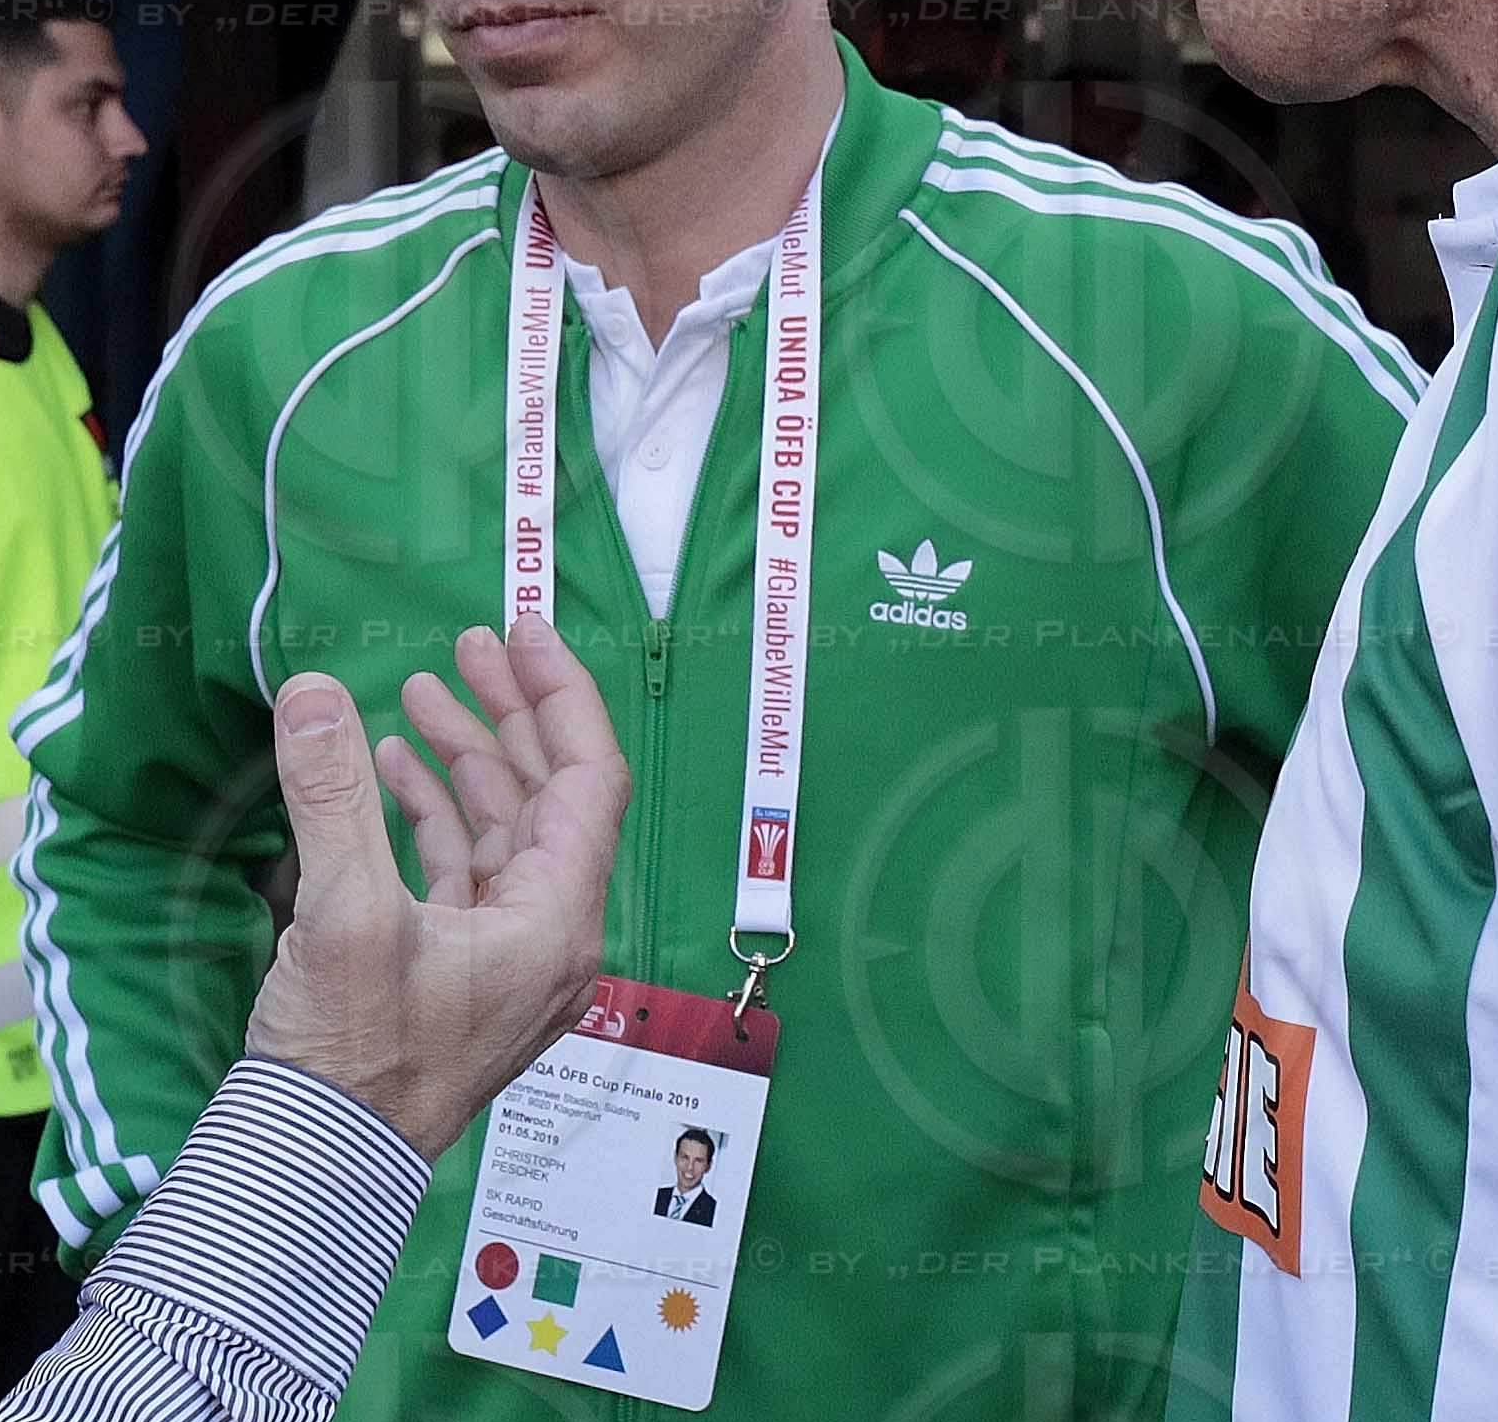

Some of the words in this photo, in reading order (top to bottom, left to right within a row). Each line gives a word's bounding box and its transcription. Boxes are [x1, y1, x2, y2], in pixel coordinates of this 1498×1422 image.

[774, 315, 808, 406] UNIQA
[516, 286, 553, 497] #GlaubeWilleMut
[774, 414, 815, 471] ÖFB
[771, 480, 801, 539] CUP
[516, 516, 543, 573] CUP
[869, 601, 968, 631] adidas
[758, 556, 798, 779] #GlaubeWilleMut
[558, 1065, 589, 1085] ÖFB
[592, 1075, 620, 1093] Cup
[622, 1082, 664, 1103] Finale
[667, 1092, 700, 1111] 2019
[498, 1122, 561, 1147] 01.05.2019
[502, 1106, 555, 1130] Mittwoch
[490, 1158, 550, 1183] PESCHEK
[494, 1145, 567, 1172] CHRISTOPH
[504, 1192, 544, 1212] RAPID
